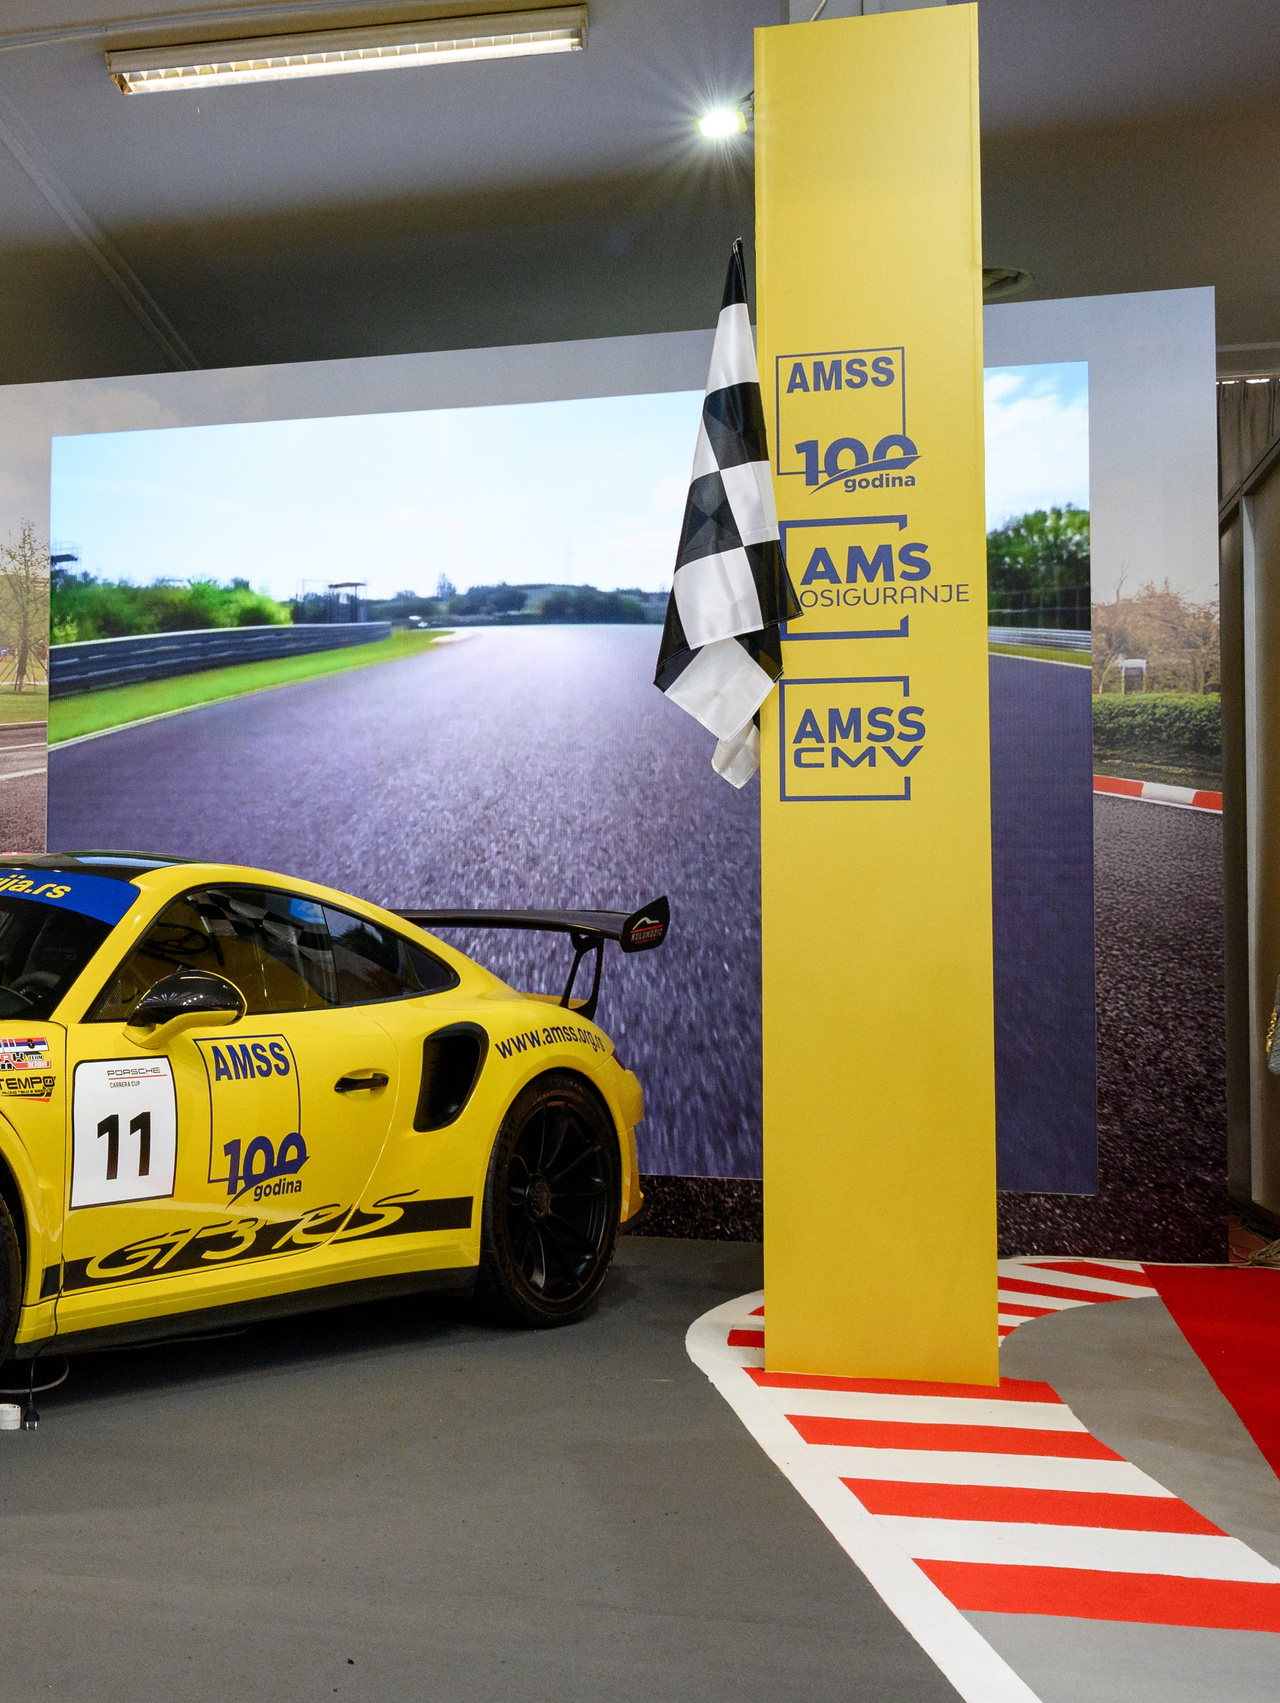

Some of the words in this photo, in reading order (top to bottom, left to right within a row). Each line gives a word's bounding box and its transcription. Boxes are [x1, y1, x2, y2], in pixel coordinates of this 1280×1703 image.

[786, 356, 895, 393] AMSS
[795, 434, 920, 487] 100
[844, 473, 916, 493] godina
[800, 542, 932, 586] AMS
[799, 583, 970, 608] OSIGURANJE
[792, 706, 926, 744] AMSS
[794, 746, 924, 768] CMV
[495, 1026, 605, 1059] www.amss.org.rs
[107, 1066, 161, 1076] PORSCHE
[211, 1042, 290, 1081] AMSS
[109, 1081, 131, 1089] CARRERA
[97, 1111, 151, 1181] 11
[223, 1132, 310, 1196] 100
[253, 1178, 303, 1202] godina
[86, 1217, 268, 1280] GT3
[271, 1189, 420, 1250] RS
